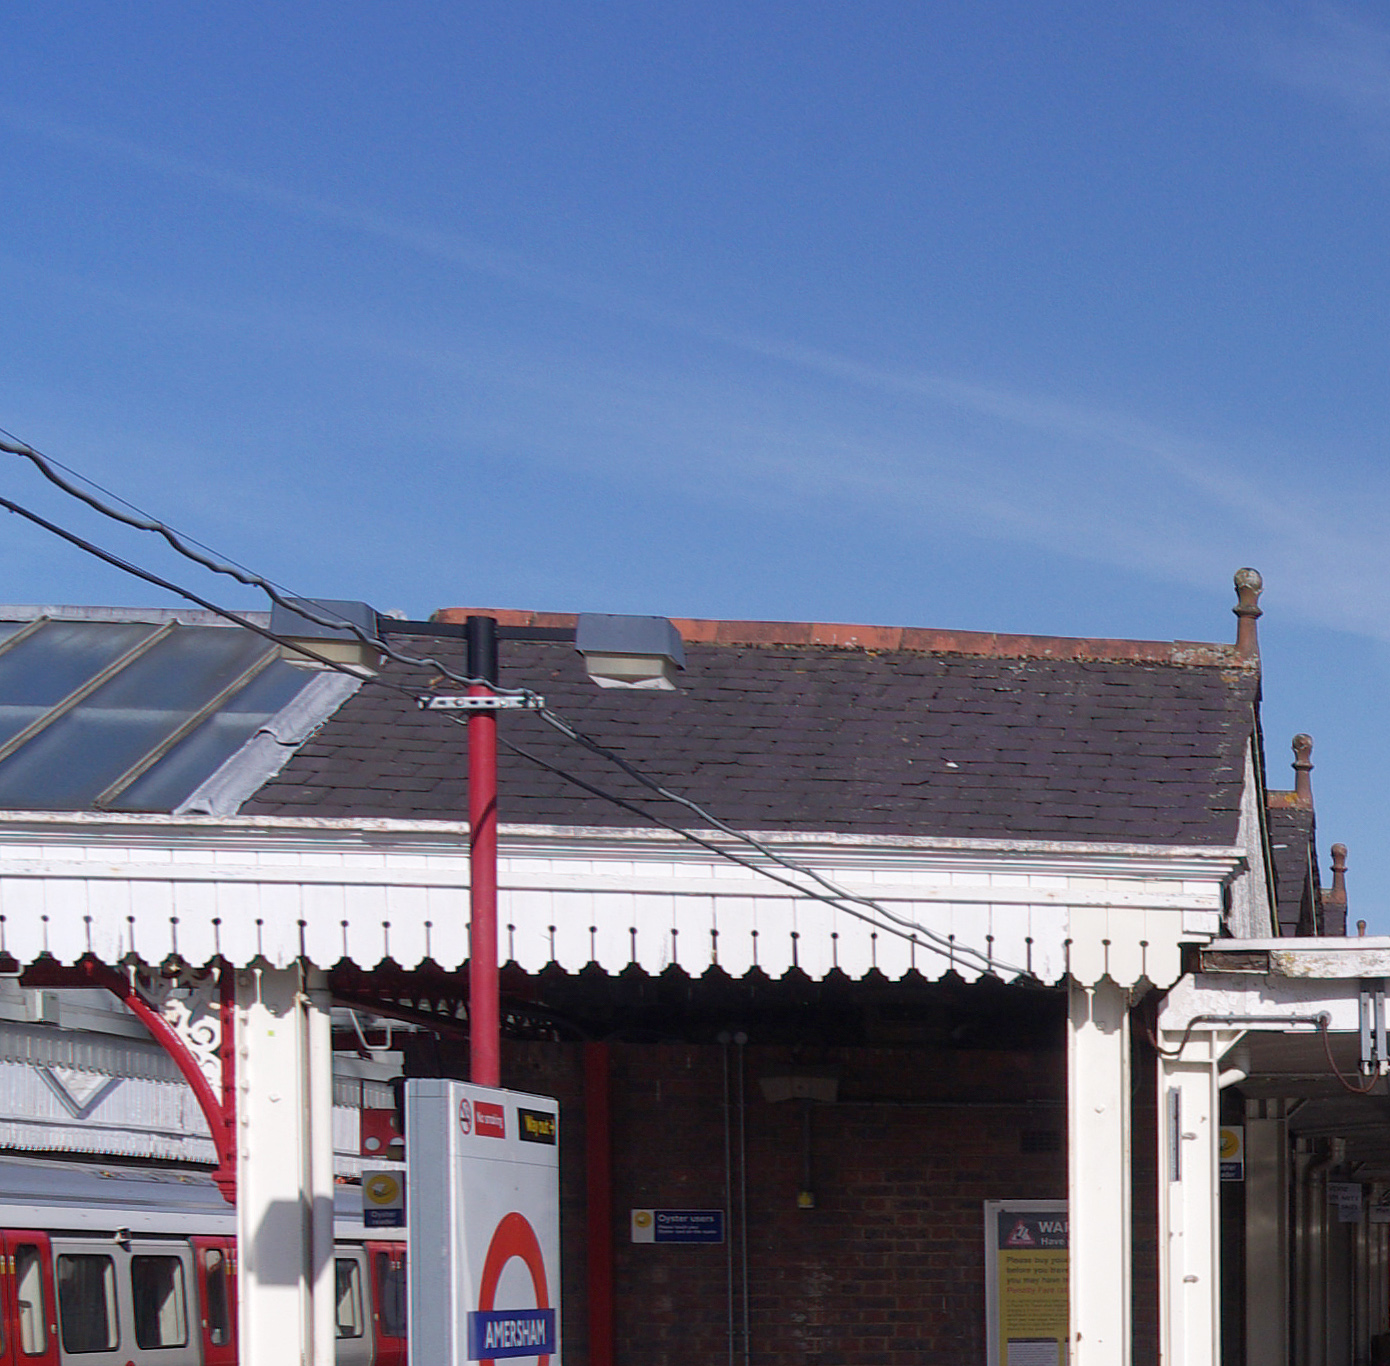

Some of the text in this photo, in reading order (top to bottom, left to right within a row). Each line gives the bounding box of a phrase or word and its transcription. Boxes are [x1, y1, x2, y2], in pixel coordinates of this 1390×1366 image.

[524, 1114, 551, 1137] Way out
[658, 1214, 715, 1224] Oyster users
[485, 1319, 546, 1349] AMERSHAM
